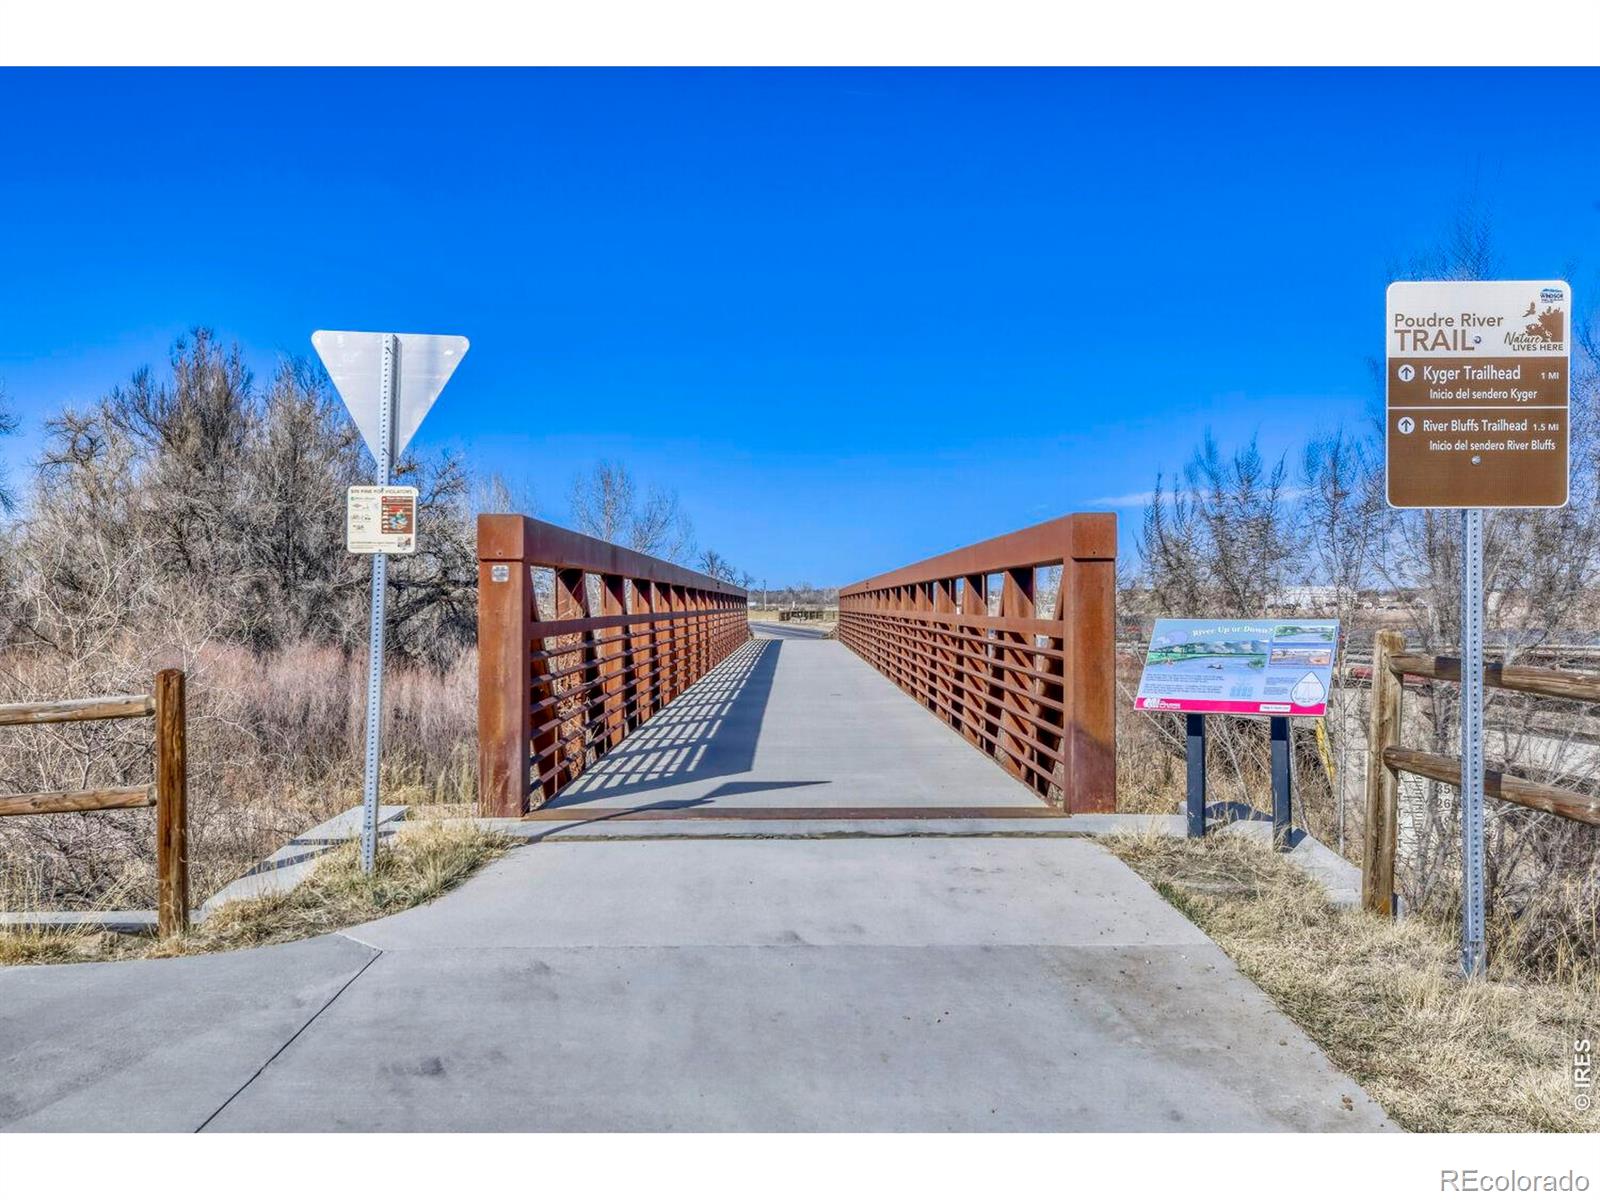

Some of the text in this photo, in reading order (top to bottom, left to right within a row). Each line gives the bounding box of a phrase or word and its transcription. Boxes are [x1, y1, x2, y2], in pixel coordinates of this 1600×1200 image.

[1394, 312, 1504, 328] Poudre River
[1394, 329, 1475, 352] TRAIL
[1504, 332, 1542, 346] Nature
[1423, 365, 1560, 384] Kyger Trailhead 1 MI
[1429, 388, 1538, 402] Inicio del sendero Kyger
[1423, 419, 1559, 432] River Bluffs Trailhead 1.5 MI
[1429, 439, 1556, 451] Inicio del sendero River Bluffs
[1192, 629, 1214, 637] River
[1218, 625, 1230, 634] Up
